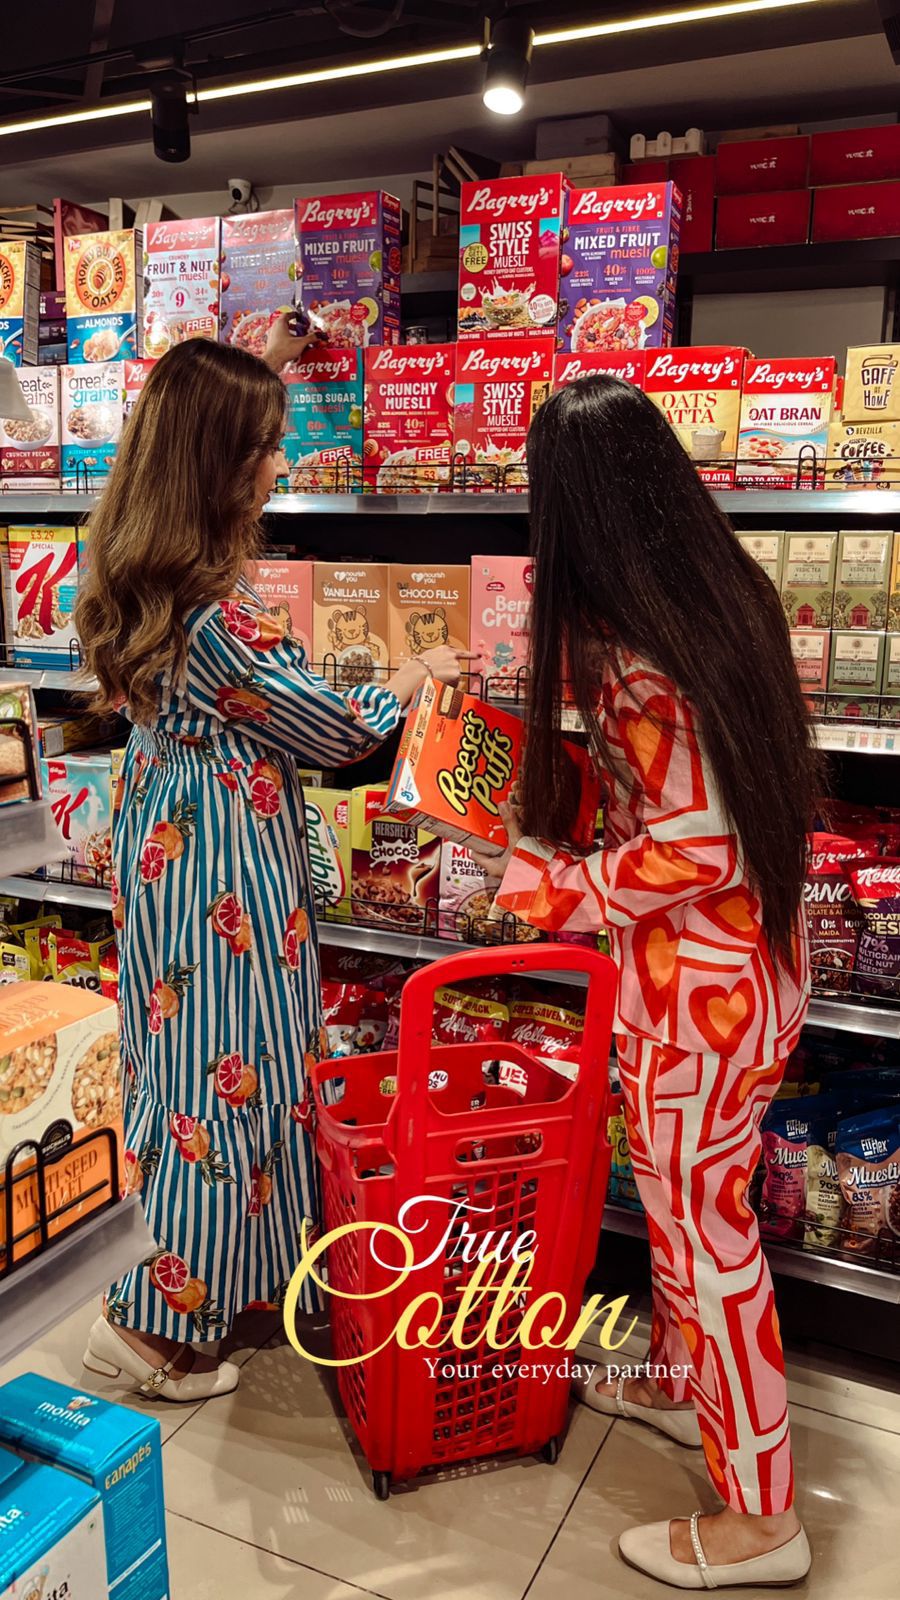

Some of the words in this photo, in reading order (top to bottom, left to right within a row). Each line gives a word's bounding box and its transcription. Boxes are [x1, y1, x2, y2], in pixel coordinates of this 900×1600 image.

[467, 187, 549, 217] Bagrry's
[573, 191, 656, 220] Bagrry's
[301, 200, 370, 228] Bagrry's
[489, 221, 532, 240] SWISS
[304, 241, 340, 255] MIXED
[343, 239, 376, 253] FRUIT
[489, 238, 529, 257] STYLE
[574, 234, 615, 250] MIXED
[620, 232, 661, 247] FRUIT
[610, 246, 650, 259] muesli
[79, 248, 95, 287] HONEY
[97, 246, 123, 282] BUNCHES
[147, 263, 176, 275] FRUIT
[179, 261, 186, 273] &
[191, 260, 213, 272] NUT
[465, 257, 487, 266] FREE
[494, 255, 526, 268] MUESLI
[179, 272, 208, 282] muesli
[91, 288, 118, 308] OATS
[175, 291, 185, 308] 9
[84, 316, 123, 329] ALMONDS
[186, 318, 212, 331] FREE
[282, 356, 350, 380] Bagrry's
[372, 348, 444, 376] Bagrry's
[462, 348, 541, 377] Bagrry's
[647, 353, 736, 383] Bagrry's
[68, 373, 105, 391] great
[747, 363, 824, 389] Bagrry's
[861, 367, 896, 386] CAFE
[379, 382, 438, 396] CRUNCHY
[483, 382, 525, 399] SWISS
[69, 388, 119, 409] grains
[293, 393, 323, 404] ADDED
[325, 392, 356, 403] SUGAR
[385, 397, 431, 410] MUESLI
[661, 392, 717, 409] OATS
[864, 389, 890, 407] HOME
[482, 399, 522, 415] STYLE
[749, 408, 776, 421] OAT
[780, 407, 822, 421] BRAN
[487, 415, 518, 426] MUESLI
[664, 409, 715, 424] ATTA
[856, 427, 882, 435] BEVZILLA
[322, 447, 351, 463] FREE
[418, 447, 450, 461] FREE
[841, 441, 885, 458] COFFEE
[424, 470, 436, 480] 53
[711, 473, 730, 481] ATTA
[30, 530, 55, 540] £3.29
[15, 542, 77, 636] K
[254, 584, 276, 593] ERRY
[276, 584, 299, 594] FILLS
[323, 588, 357, 598] VANILLA
[358, 589, 380, 599] FILLS
[399, 589, 434, 599] CHOCO
[436, 590, 459, 600] FILLS
[496, 595, 531, 612] Berr
[482, 607, 532, 629] Crun
[437, 709, 486, 815] Reese's
[471, 729, 513, 815] Puffs
[375, 822, 416, 839] HERSHEY'S
[371, 846, 418, 859] CHOCOS
[451, 867, 458, 875] &
[459, 868, 488, 877] SEEDS
[857, 864, 900, 887] Kell
[821, 919, 836, 929] 0%
[59, 946, 89, 957] Kellogg's
[876, 960, 894, 968] NUT
[513, 1004, 534, 1016] SUPER
[535, 1006, 563, 1022] SAVER
[512, 1023, 572, 1053] Kellogg's
[770, 1147, 808, 1166] Mues
[16, 1149, 98, 1214] MUTI-SEED
[847, 1162, 899, 1185] Muesli
[852, 1191, 872, 1202] 83%
[37, 1401, 91, 1427] monita
